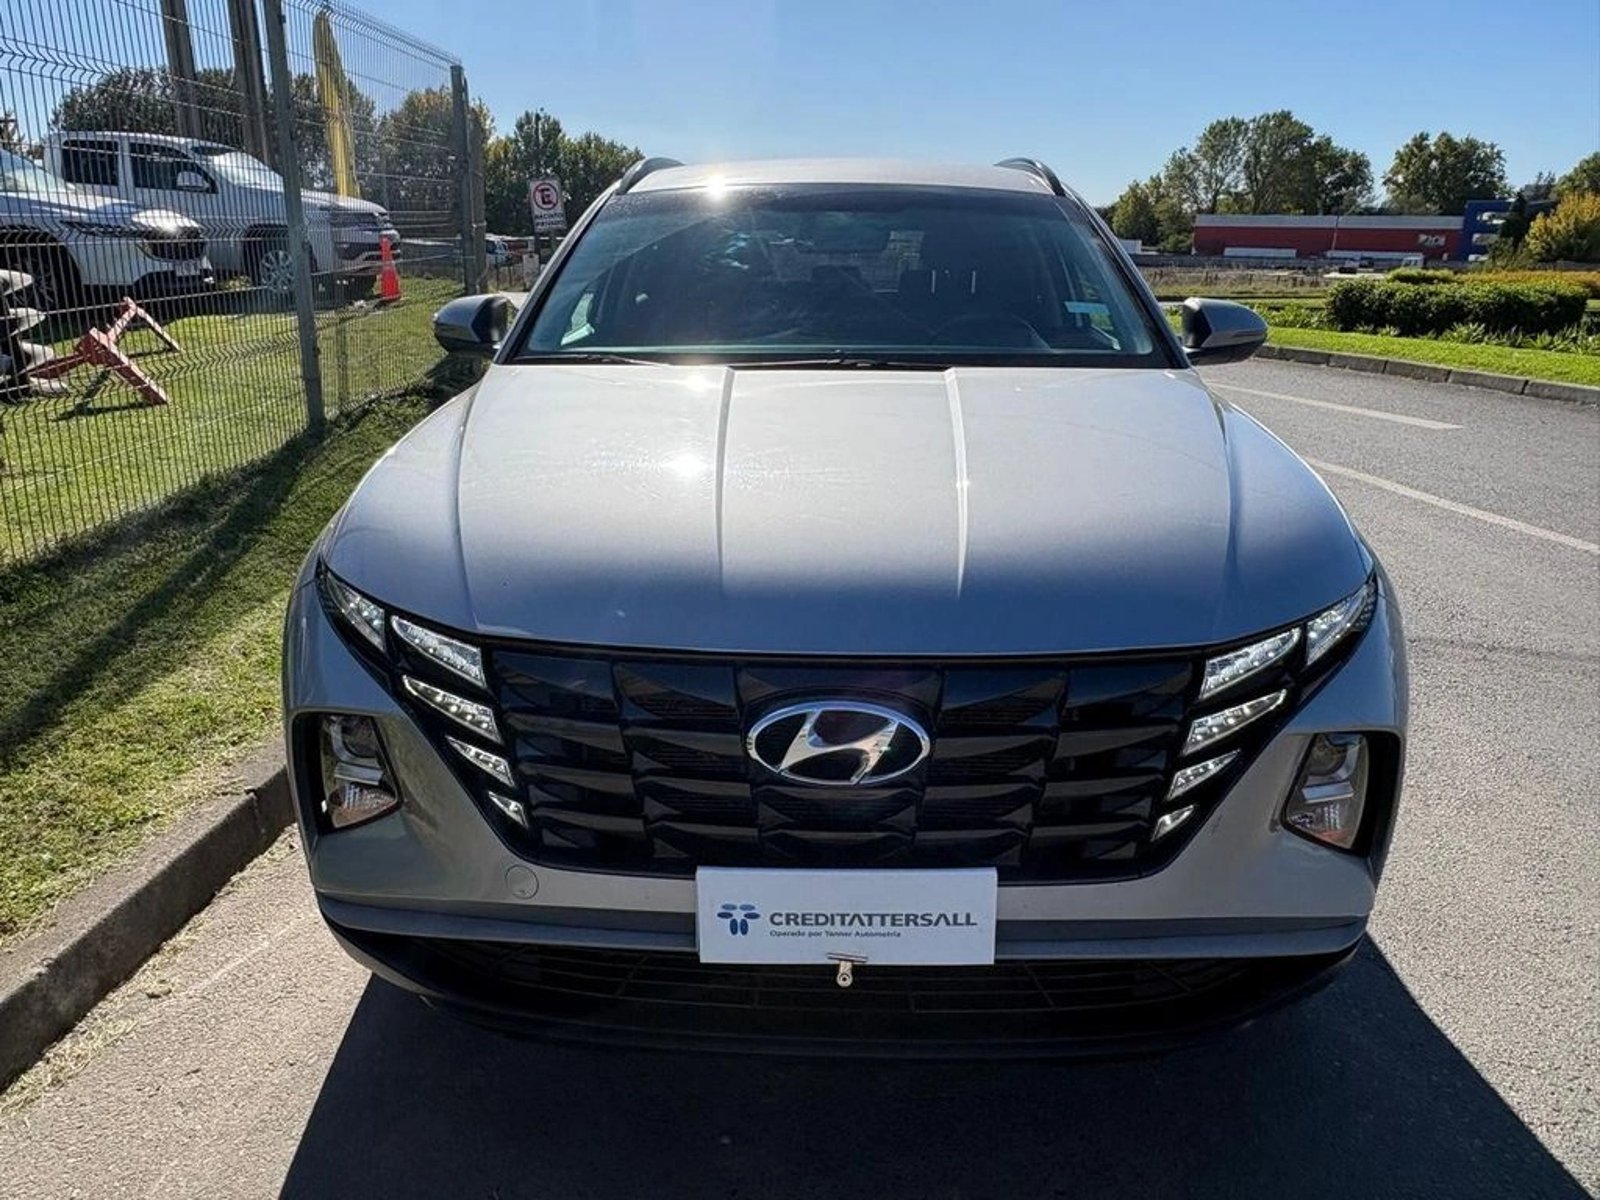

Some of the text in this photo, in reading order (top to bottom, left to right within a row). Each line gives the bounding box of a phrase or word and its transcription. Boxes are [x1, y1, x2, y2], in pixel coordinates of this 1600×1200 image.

[769, 912, 978, 927] CREDITATTERSALL
[770, 930, 806, 938] Operado
[808, 931, 822, 939] por
[826, 930, 851, 938] Tanner
